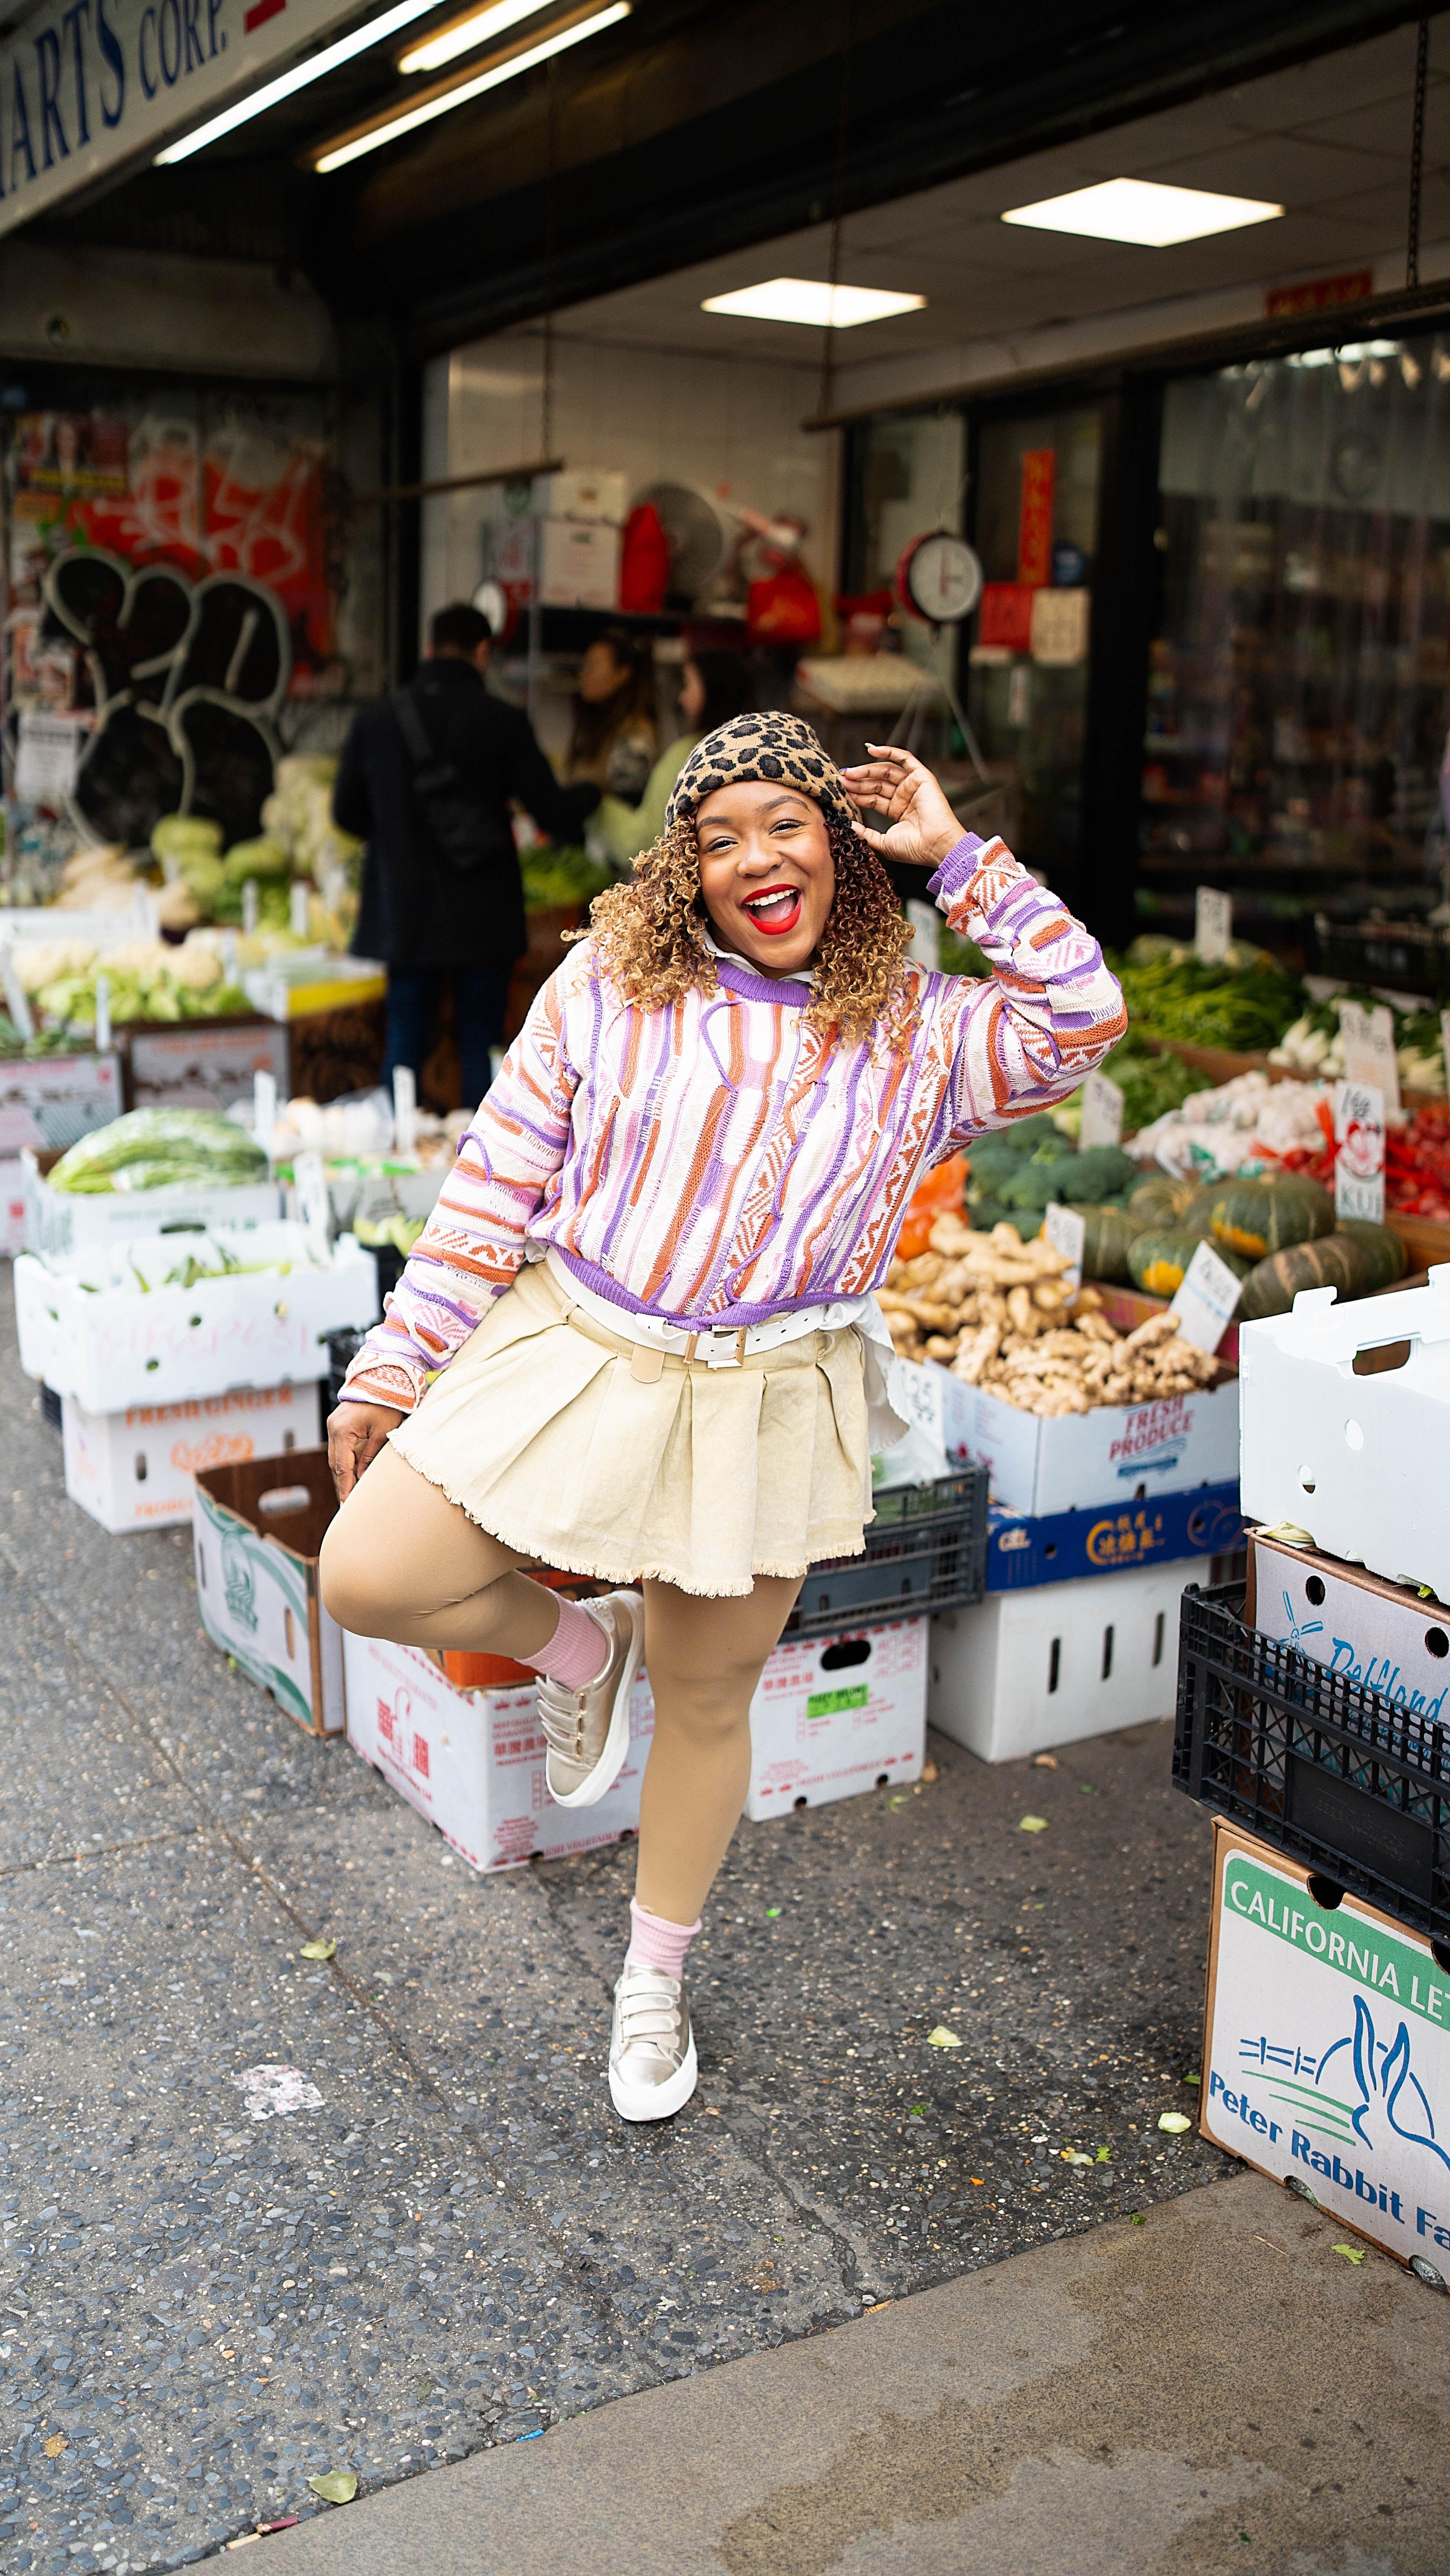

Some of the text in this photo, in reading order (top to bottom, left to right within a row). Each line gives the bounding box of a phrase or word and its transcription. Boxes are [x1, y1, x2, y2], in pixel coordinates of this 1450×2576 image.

[0, 0, 125, 200] ARTS
[125, 1383, 293, 1428] FRESH GINGER
[1108, 1409, 1195, 1461] PRODUCE
[1125, 1395, 1184, 1435] FRESH
[1231, 1881, 1450, 2020] CALIFORNIA LE
[1209, 2070, 1283, 2143] Peter
[1292, 2129, 1405, 2225] Rabbit
